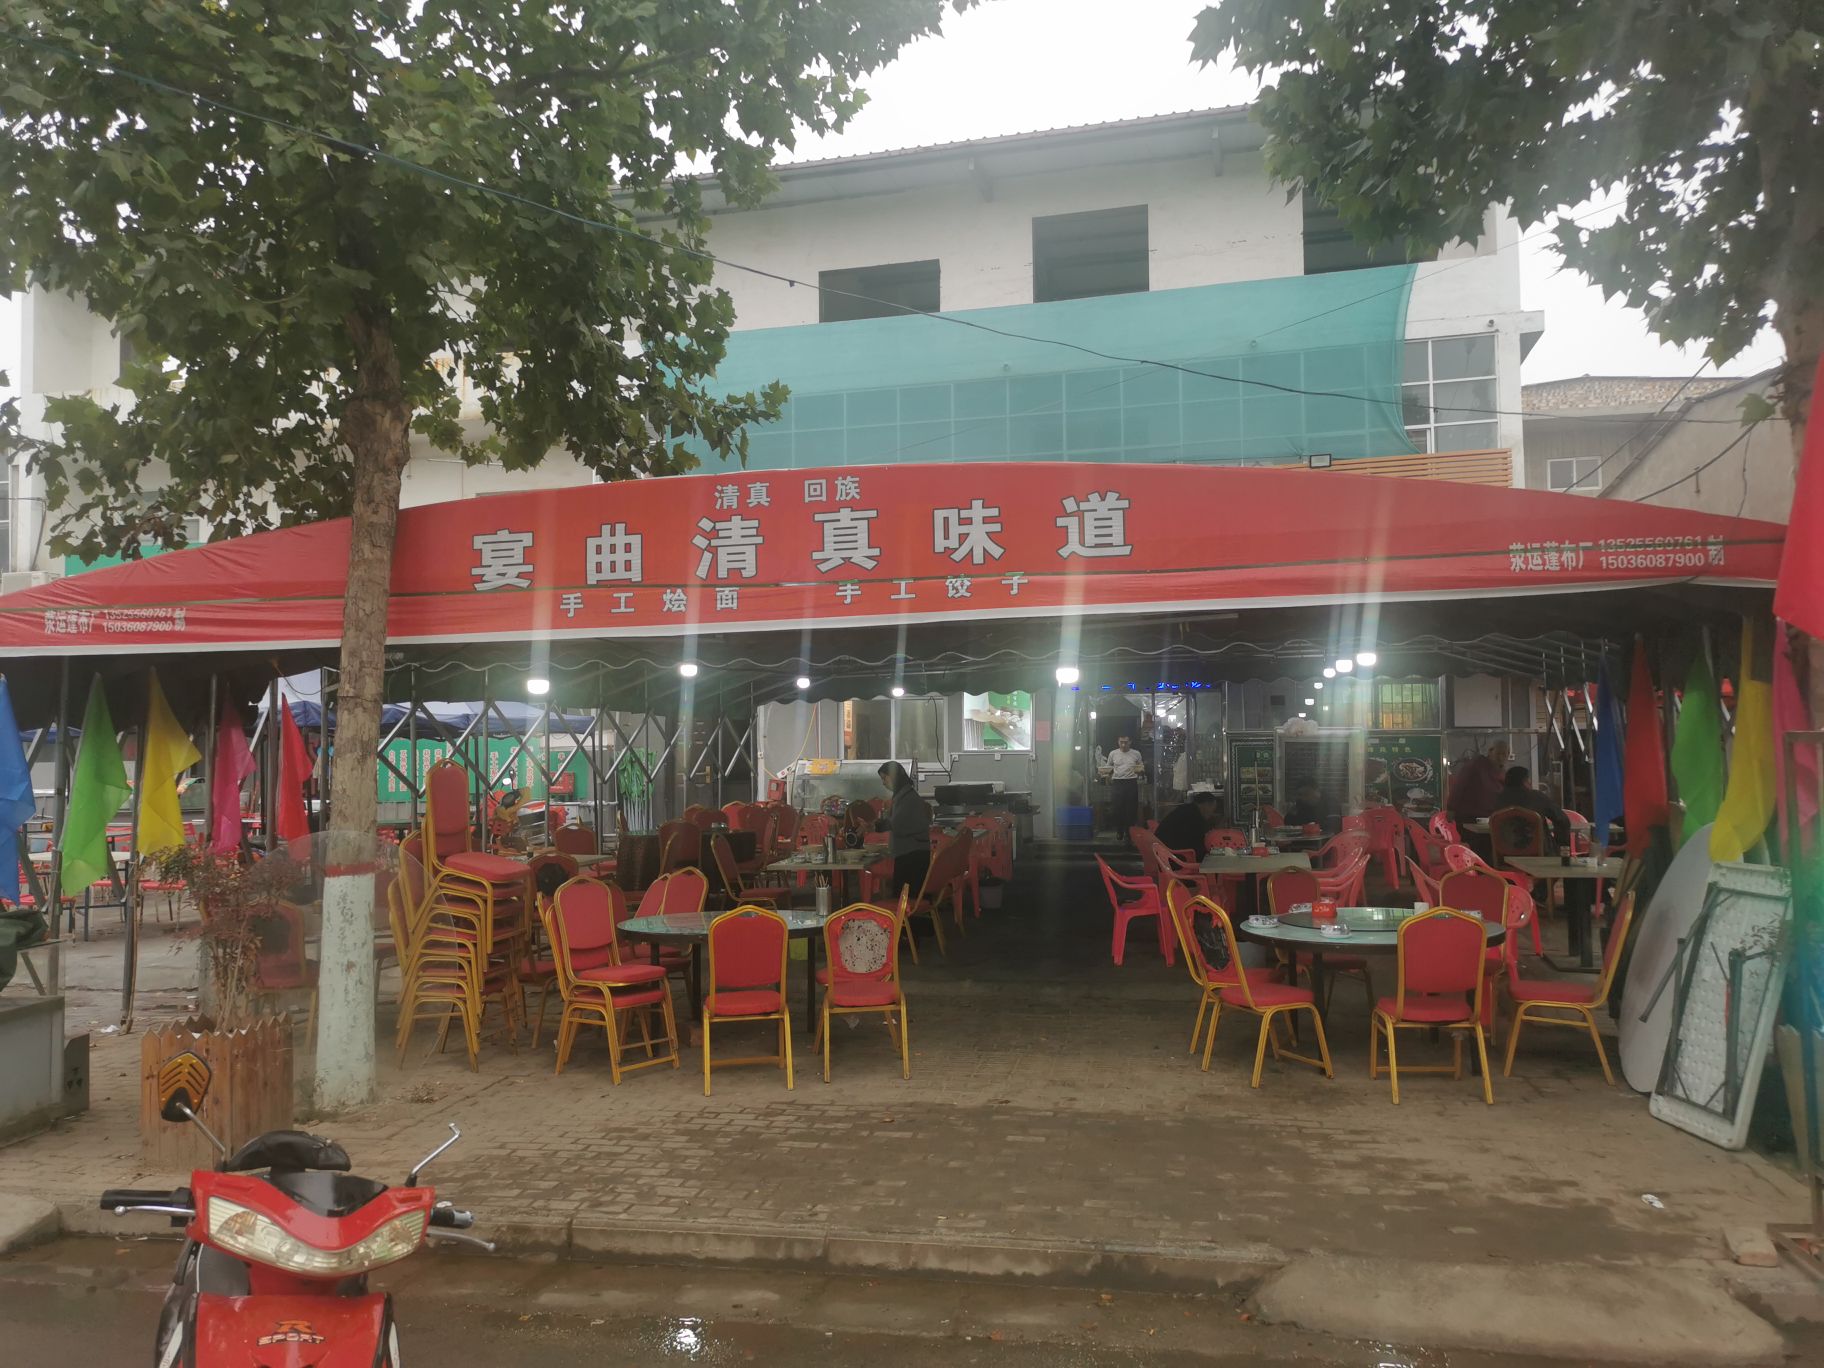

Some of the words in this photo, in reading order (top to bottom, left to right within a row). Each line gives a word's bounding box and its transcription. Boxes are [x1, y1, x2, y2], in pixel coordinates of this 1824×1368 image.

[715, 481, 770, 510] 清真
[803, 475, 861, 503] 回族
[471, 491, 1132, 590] 宴曲清真味道
[1600, 552, 1705, 569] 15036087900
[560, 587, 740, 618] 手工烩面
[835, 572, 1029, 605] 手工饺子
[102, 620, 173, 634] 15036087900
[257, 1333, 325, 1346] SPORT
